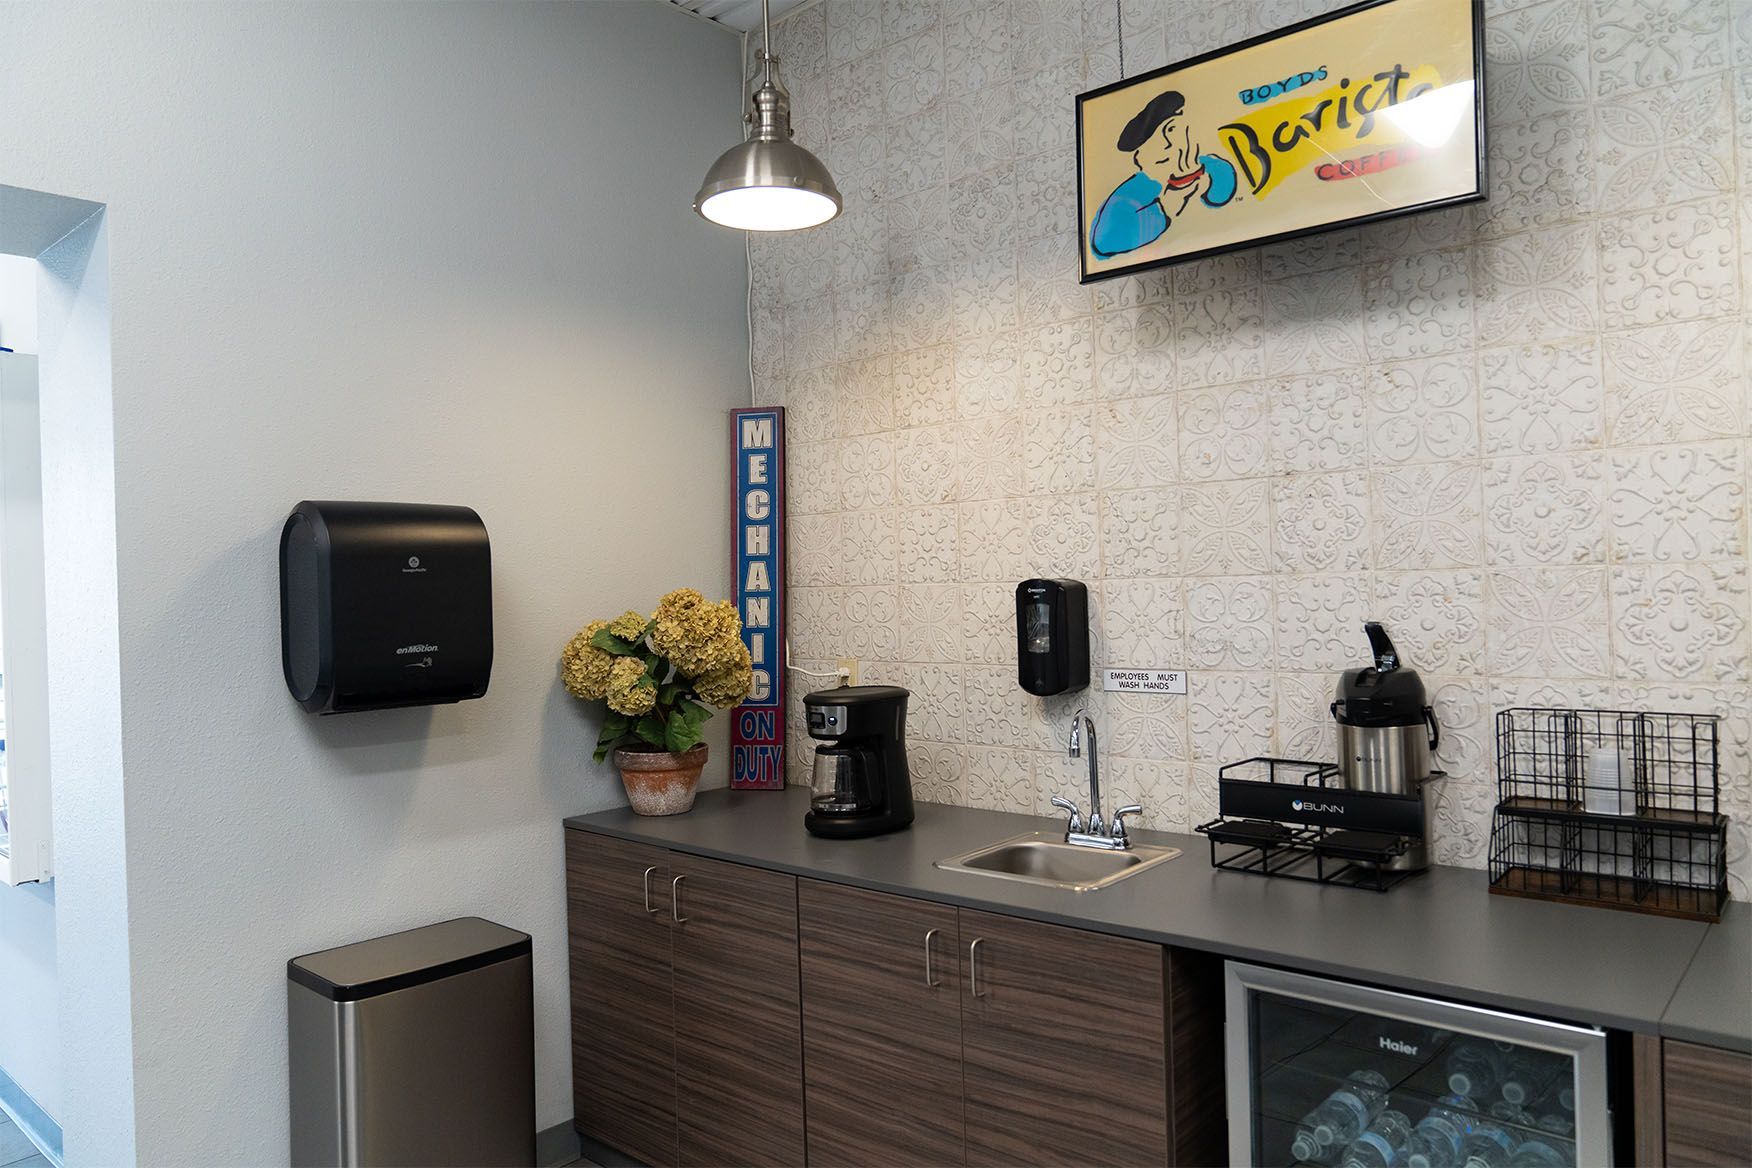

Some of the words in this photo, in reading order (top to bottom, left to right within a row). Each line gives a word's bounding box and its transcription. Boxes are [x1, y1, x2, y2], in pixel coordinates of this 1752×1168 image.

[1239, 65, 1328, 105] BOYDS
[1317, 149, 1424, 181] COFF
[742, 417, 773, 703] MECHANIC
[396, 644, 438, 655] enMotion
[1110, 672, 1149, 681] EMPLOYEES
[1157, 673, 1178, 682] MUST
[1119, 681, 1140, 689] WASH
[1143, 682, 1170, 690] HANDS
[740, 710, 776, 741] ON
[733, 744, 783, 783] DUTY
[1303, 801, 1345, 814] BUNN
[1379, 1036, 1418, 1056] Haier
